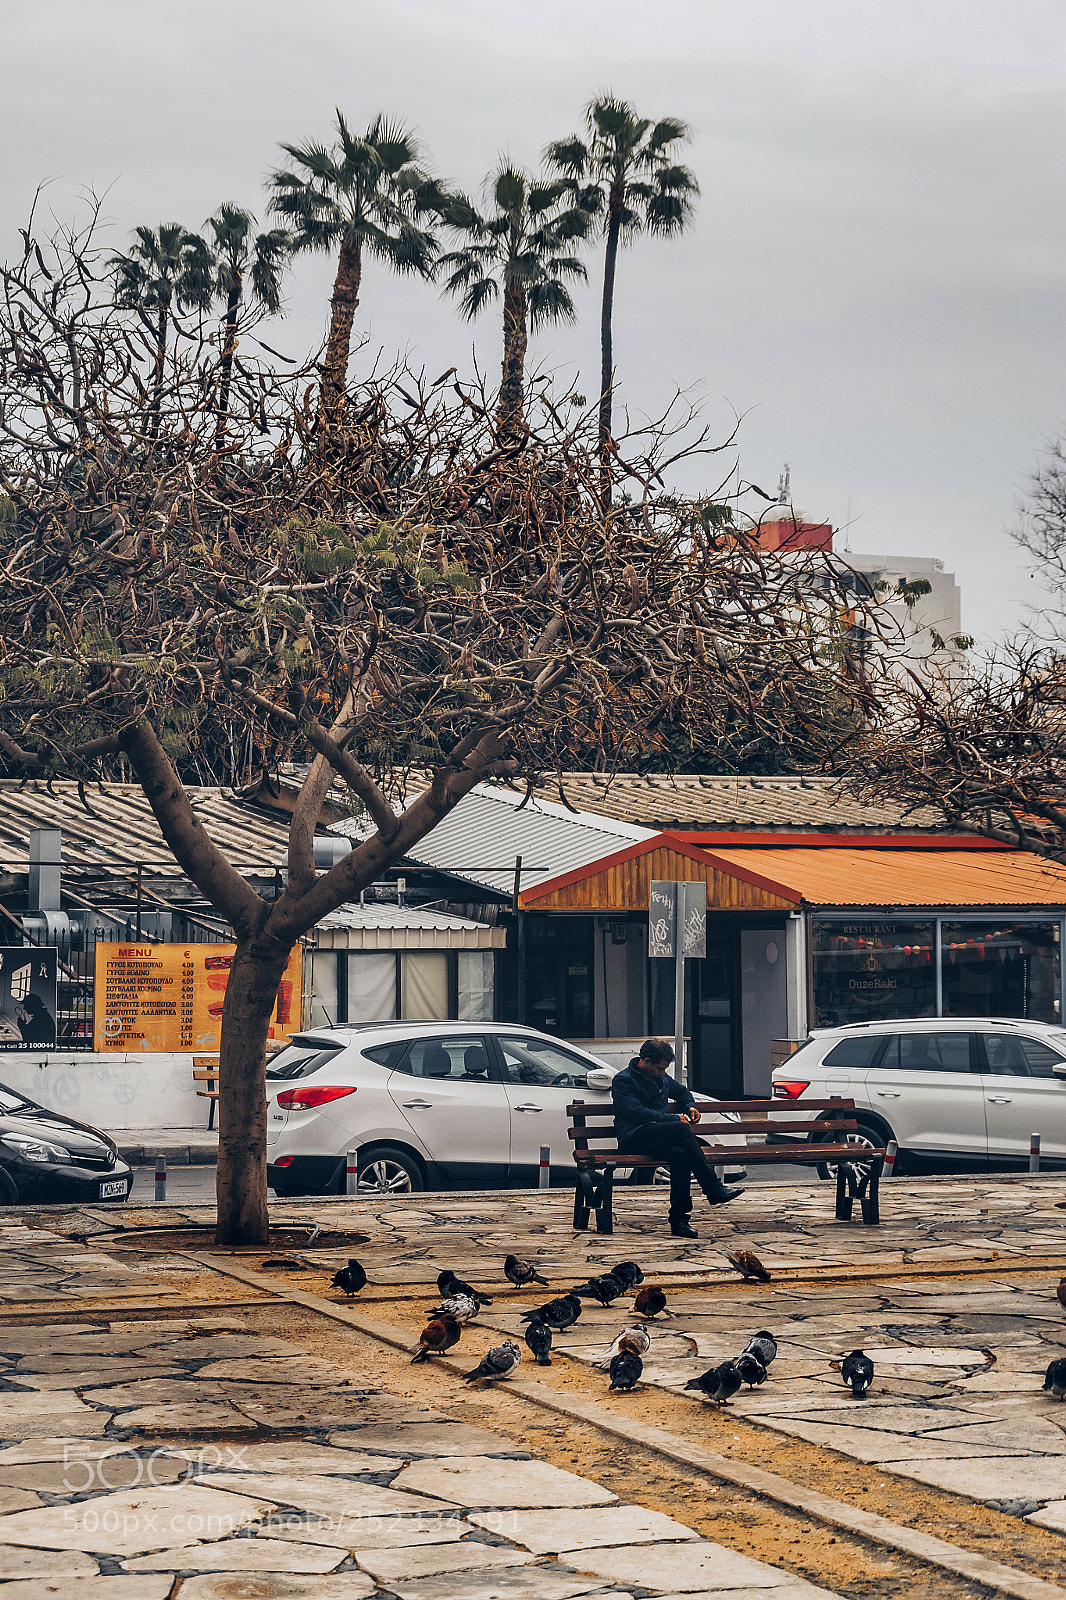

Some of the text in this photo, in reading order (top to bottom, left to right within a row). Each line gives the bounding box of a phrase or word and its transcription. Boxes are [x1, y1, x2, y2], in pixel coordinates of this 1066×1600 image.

[844, 926, 896, 934] RESTAURANT
[118, 948, 152, 956] MENU
[848, 978, 897, 989] OuzeRaki
